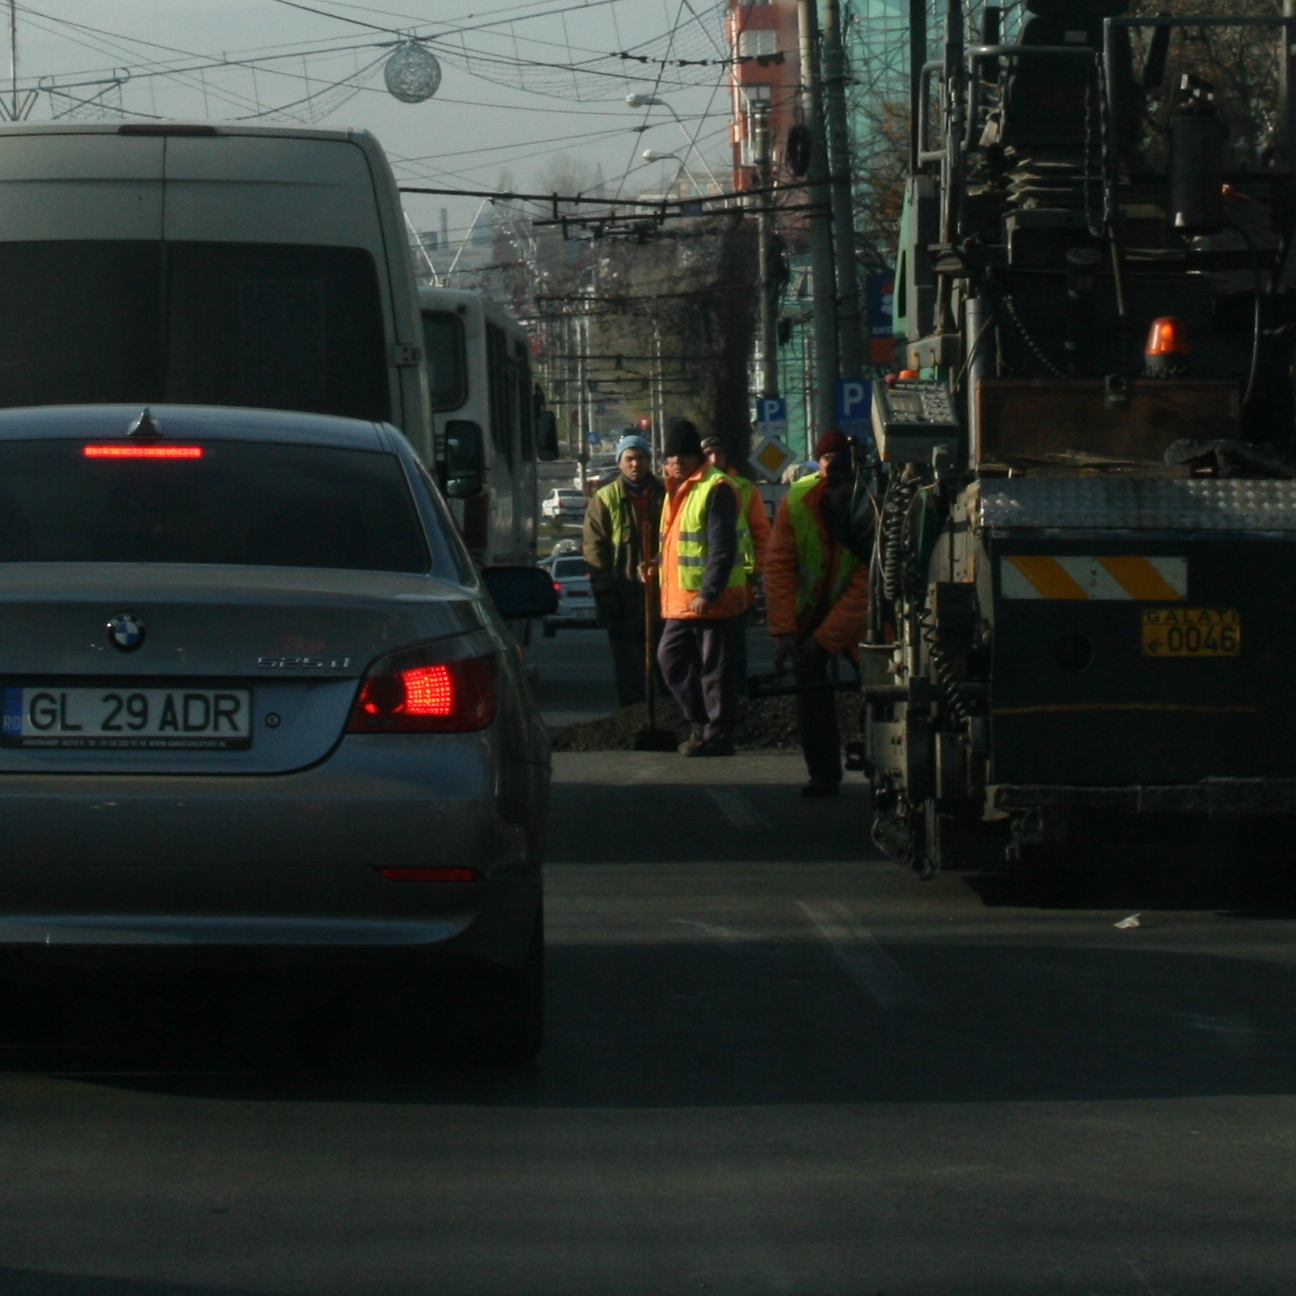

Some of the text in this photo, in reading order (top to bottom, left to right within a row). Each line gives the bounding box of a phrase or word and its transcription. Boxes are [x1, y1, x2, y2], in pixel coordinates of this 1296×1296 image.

[763, 399, 780, 422] P
[843, 382, 864, 416] P
[1167, 626, 1236, 652] 0046
[3, 715, 22, 730] RO
[29, 693, 241, 731] GL 29 ADR
